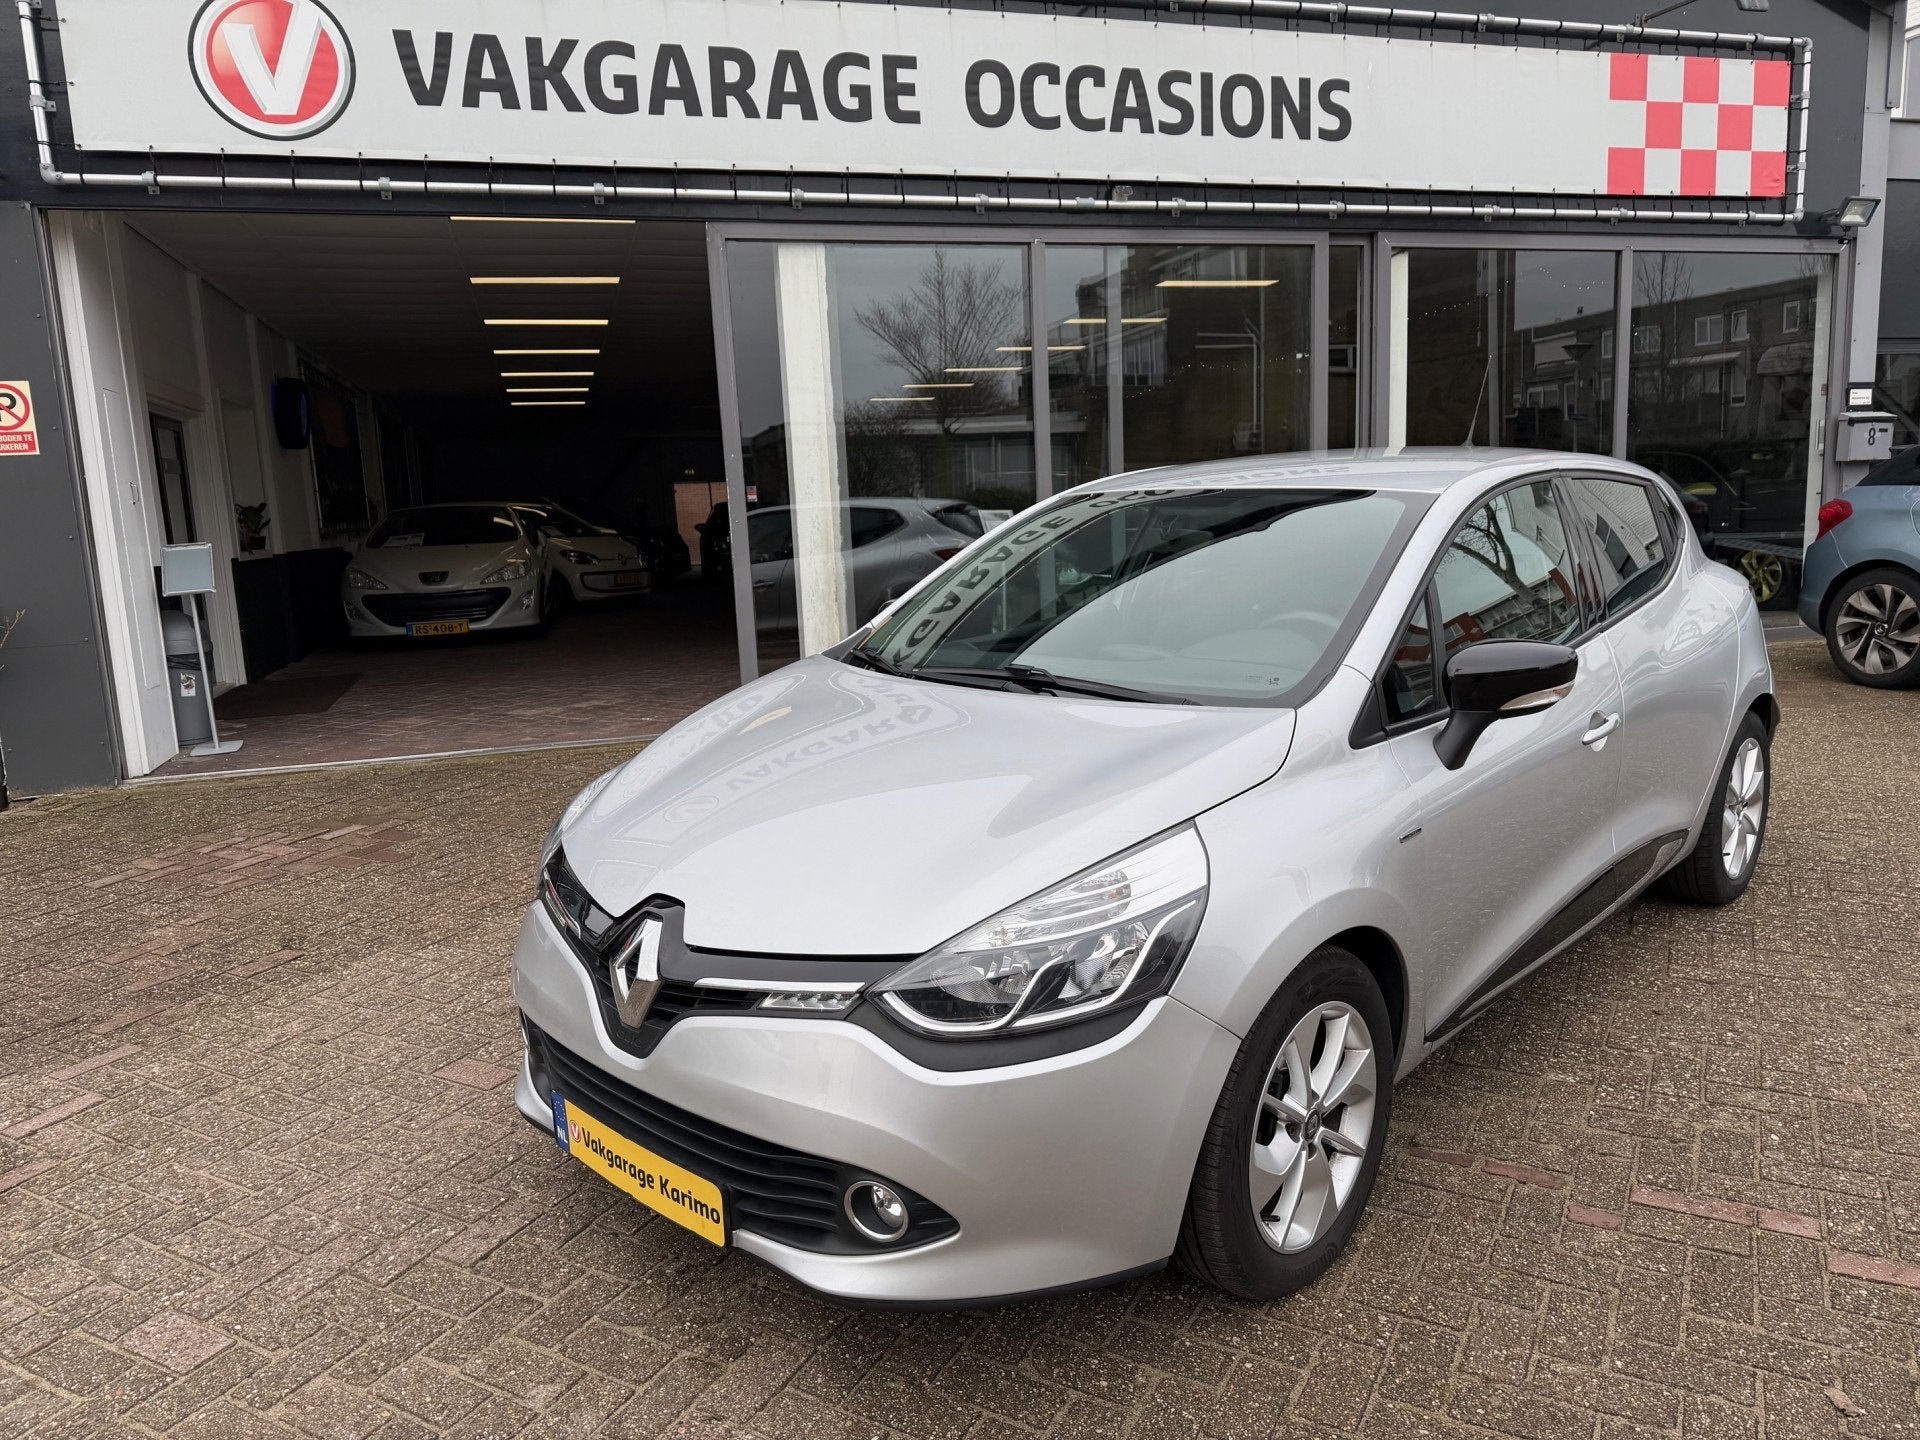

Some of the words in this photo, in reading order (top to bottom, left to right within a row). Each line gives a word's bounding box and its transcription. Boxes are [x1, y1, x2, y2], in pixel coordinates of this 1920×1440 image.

[392, 29, 921, 124] VAKGARAGE
[965, 58, 1352, 142] OCCASIONS
[1867, 427, 1876, 446] 8
[557, 1125, 568, 1144] NL
[581, 1127, 655, 1189] Vakgarage
[659, 1174, 721, 1225] Karimo
